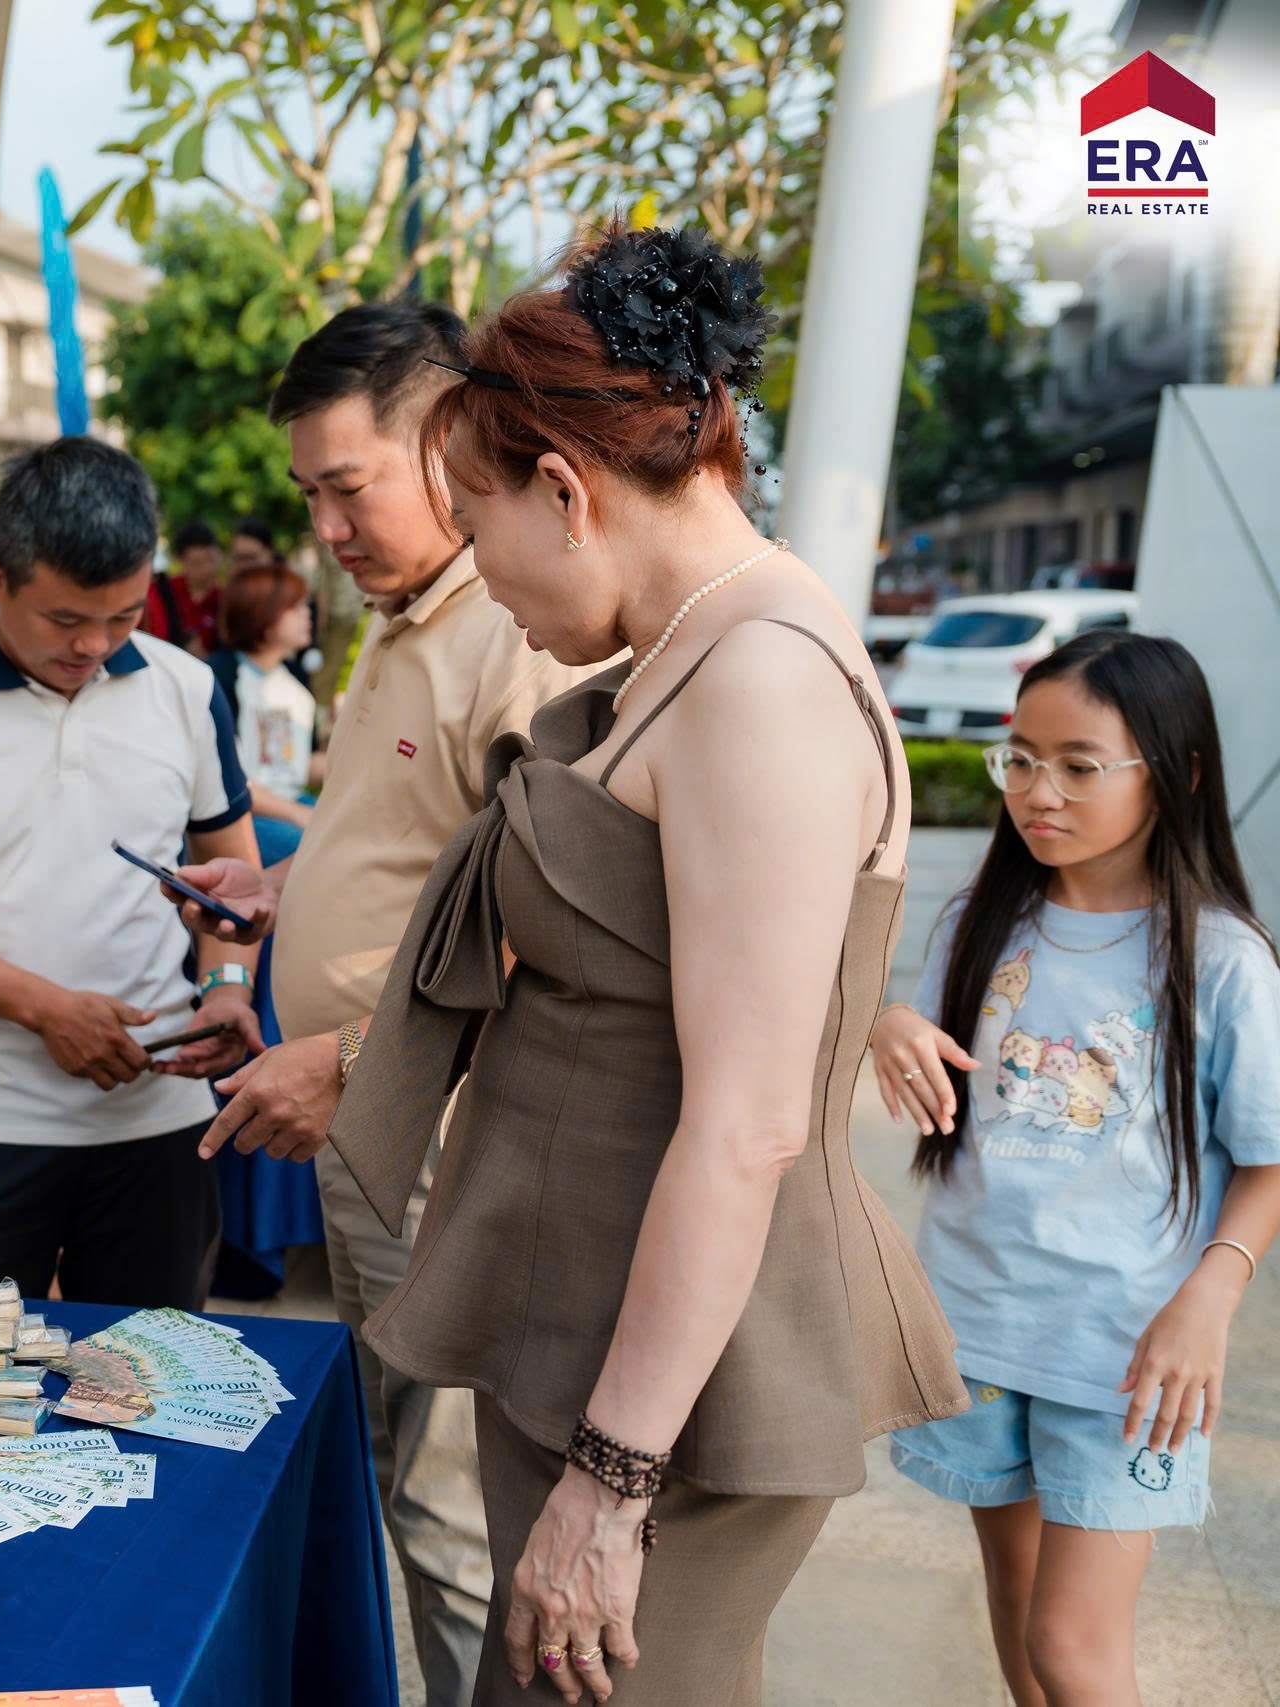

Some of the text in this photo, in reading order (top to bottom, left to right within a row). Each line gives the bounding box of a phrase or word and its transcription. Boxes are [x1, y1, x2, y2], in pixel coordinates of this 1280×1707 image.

[185, 1381, 258, 1392] 100.000
[166, 1415, 201, 1427] GROVE
[183, 1405, 258, 1426] 100.000
[203, 1423, 250, 1436] GARDEN
[29, 1438, 107, 1451] 100.000
